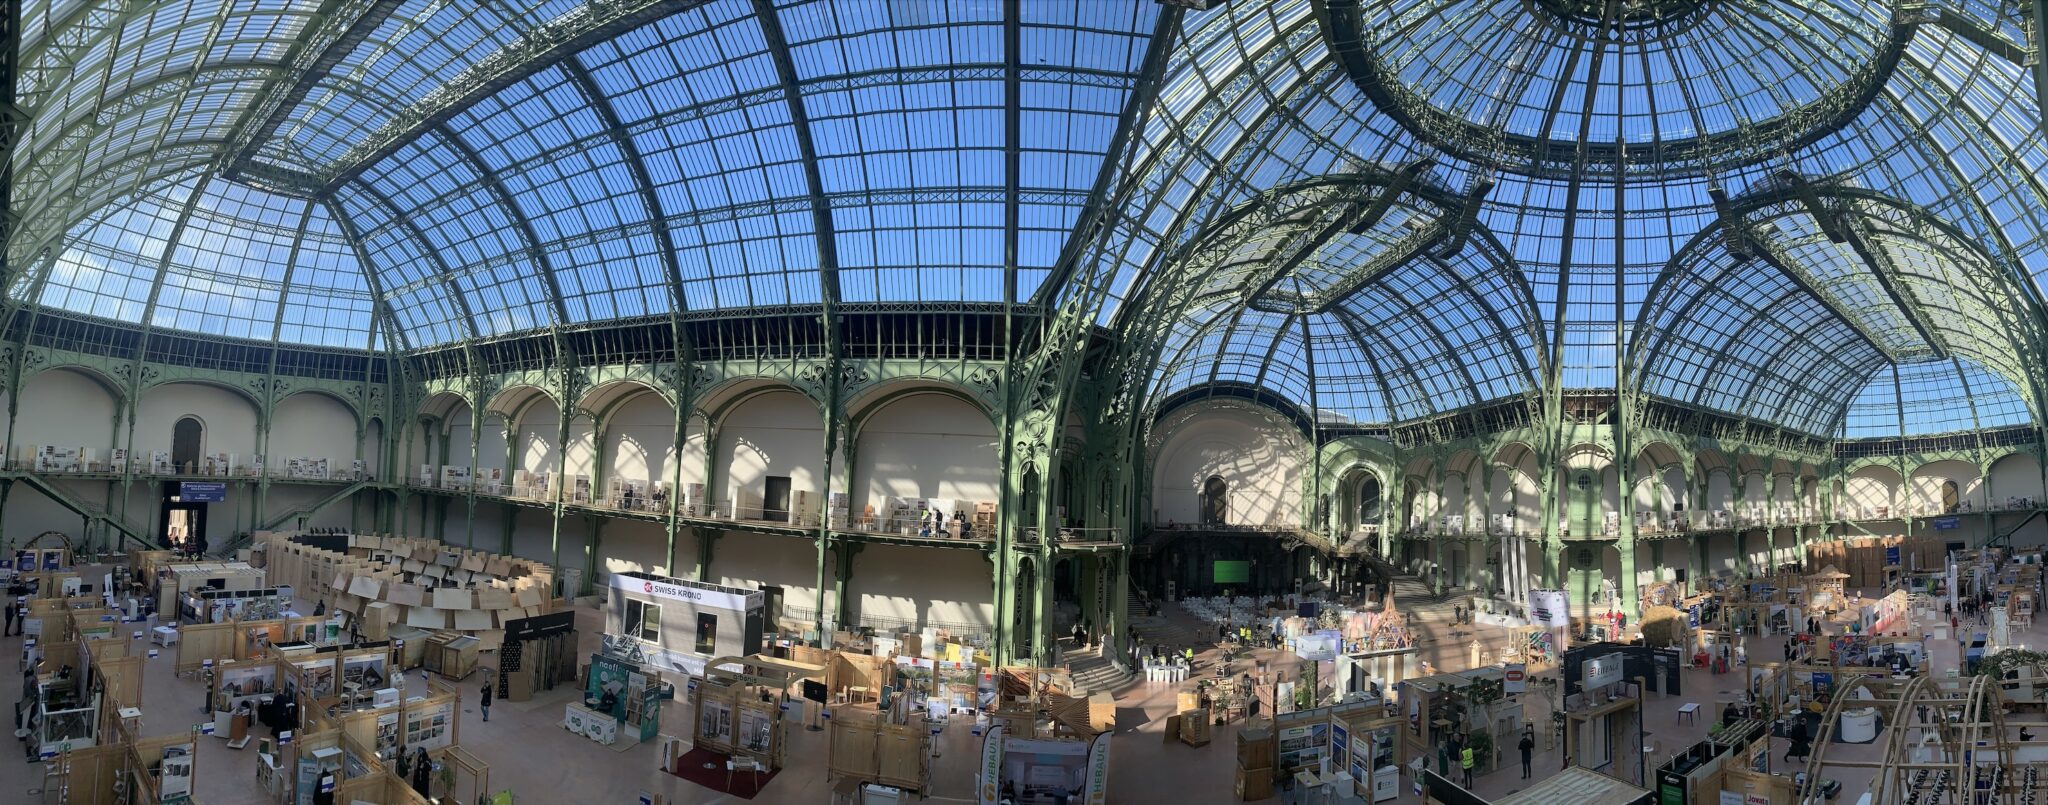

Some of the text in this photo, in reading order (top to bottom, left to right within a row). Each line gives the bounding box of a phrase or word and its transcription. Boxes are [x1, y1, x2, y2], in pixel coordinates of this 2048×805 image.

[655, 586, 702, 600] SWISS KRONO
[988, 734, 998, 784] HEBAULT
[1094, 742, 1106, 792] HEBAULT
